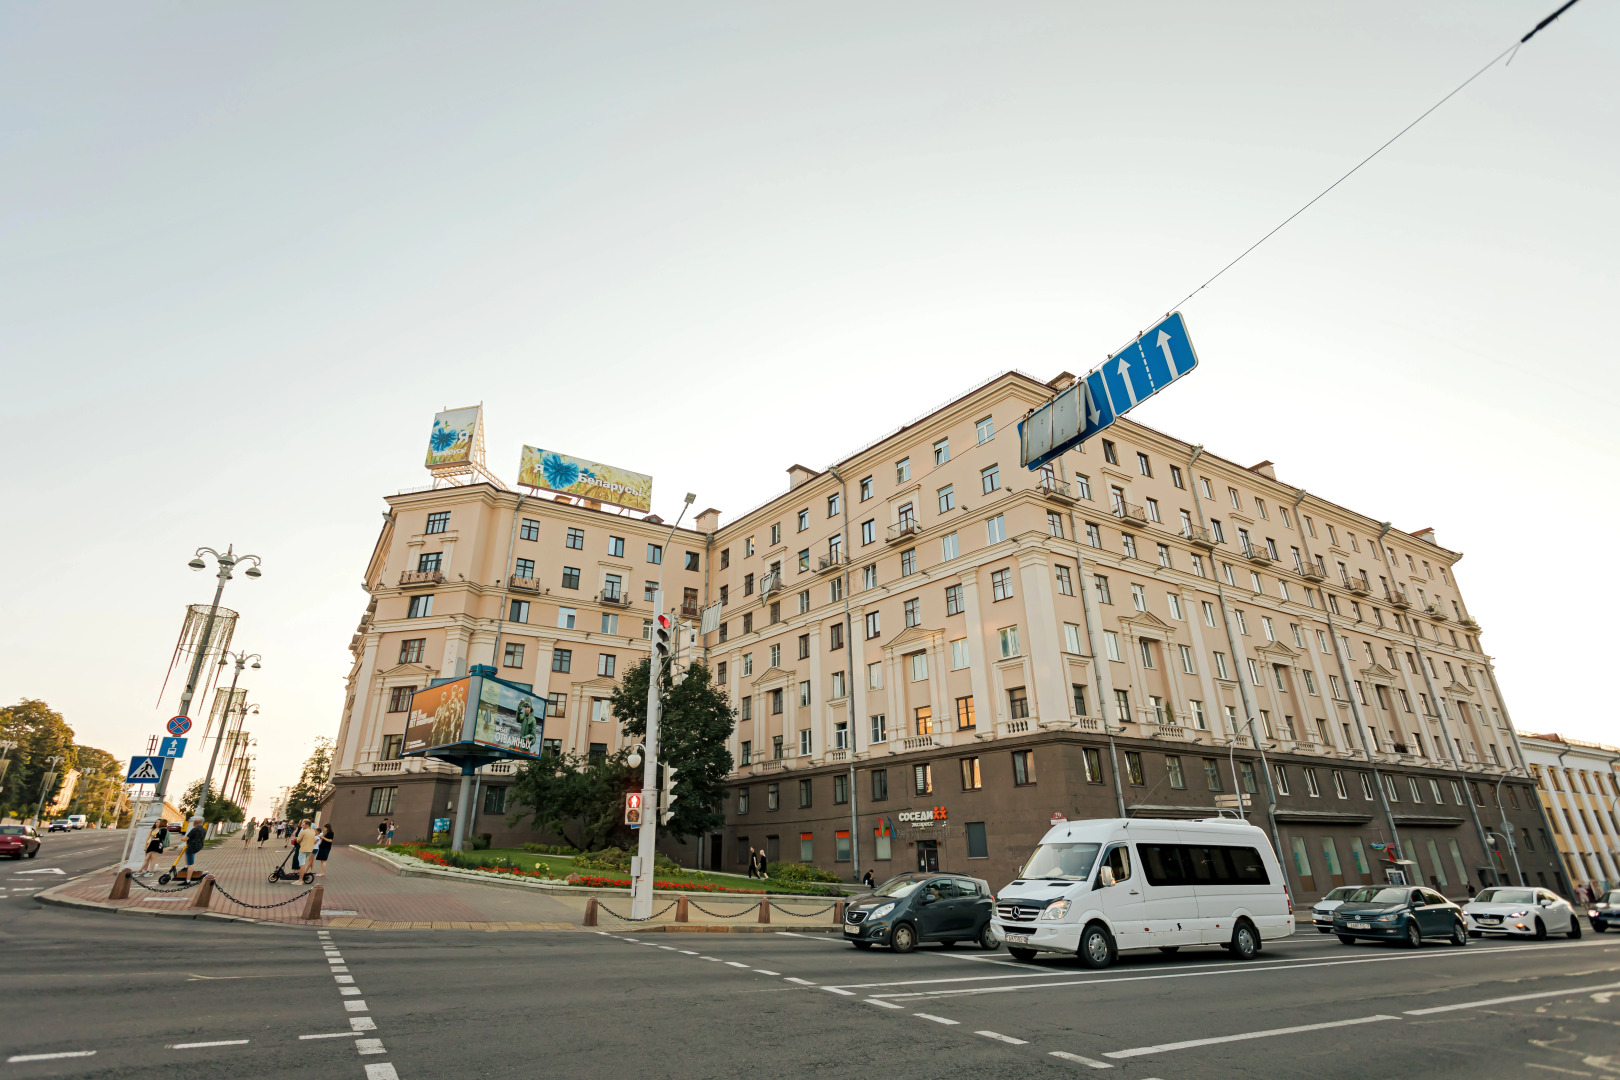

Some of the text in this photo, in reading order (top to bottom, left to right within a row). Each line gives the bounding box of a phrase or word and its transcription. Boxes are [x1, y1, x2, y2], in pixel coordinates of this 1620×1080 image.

[457, 430, 470, 443] Я
[533, 463, 643, 497] Я Беларусь!
[494, 732, 532, 750] ОТВАЖНЫХ
[898, 810, 934, 822] СОСЕДИ
